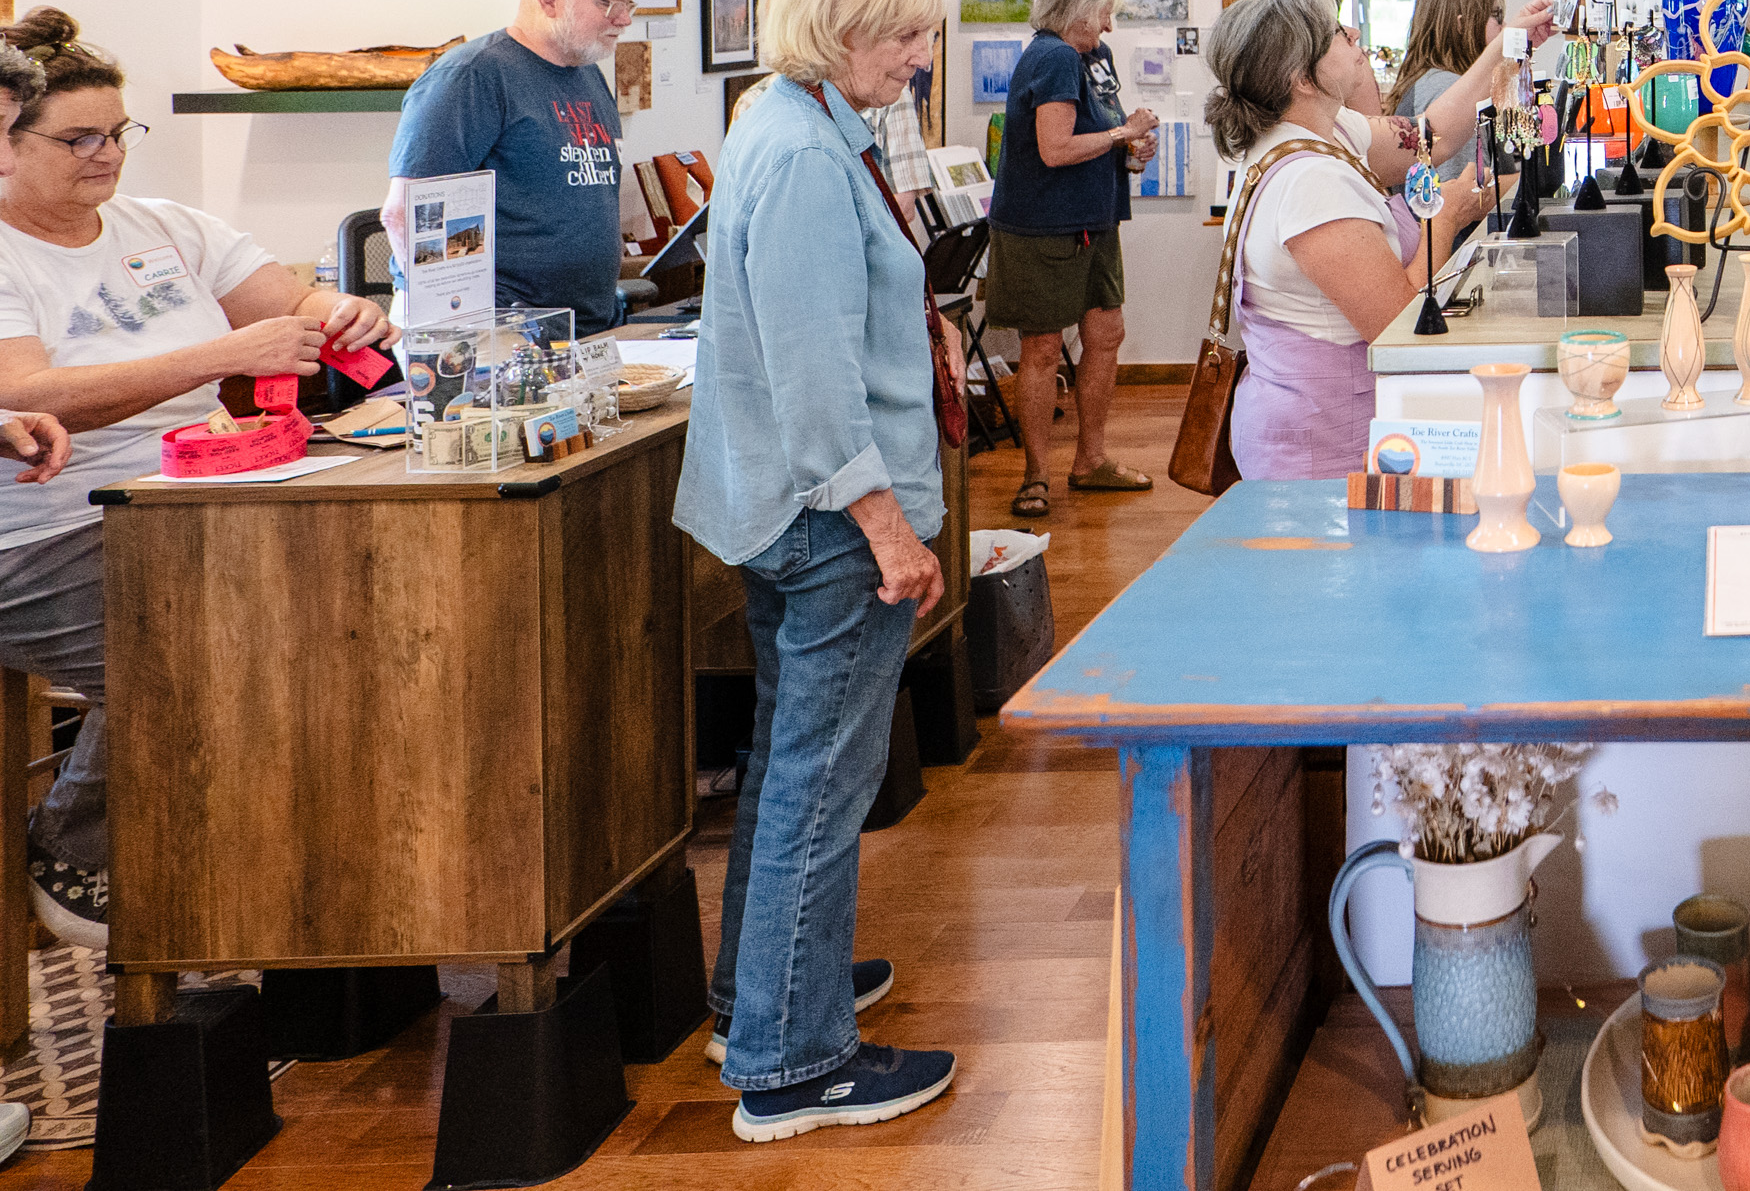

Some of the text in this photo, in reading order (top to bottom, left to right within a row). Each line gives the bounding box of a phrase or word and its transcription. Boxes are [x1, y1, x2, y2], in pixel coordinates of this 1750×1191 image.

[561, 139, 612, 171] stephen
[568, 162, 616, 185] colbert
[144, 266, 181, 281] CARRIE
[581, 342, 608, 354] LIP BALM
[592, 350, 608, 359] HONEY
[1410, 427, 1478, 437] Toe River Crafts
[1386, 1113, 1496, 1173] CELEBRATION
[1412, 1147, 1482, 1186] SERVING
[1435, 1174, 1464, 1191] SET
